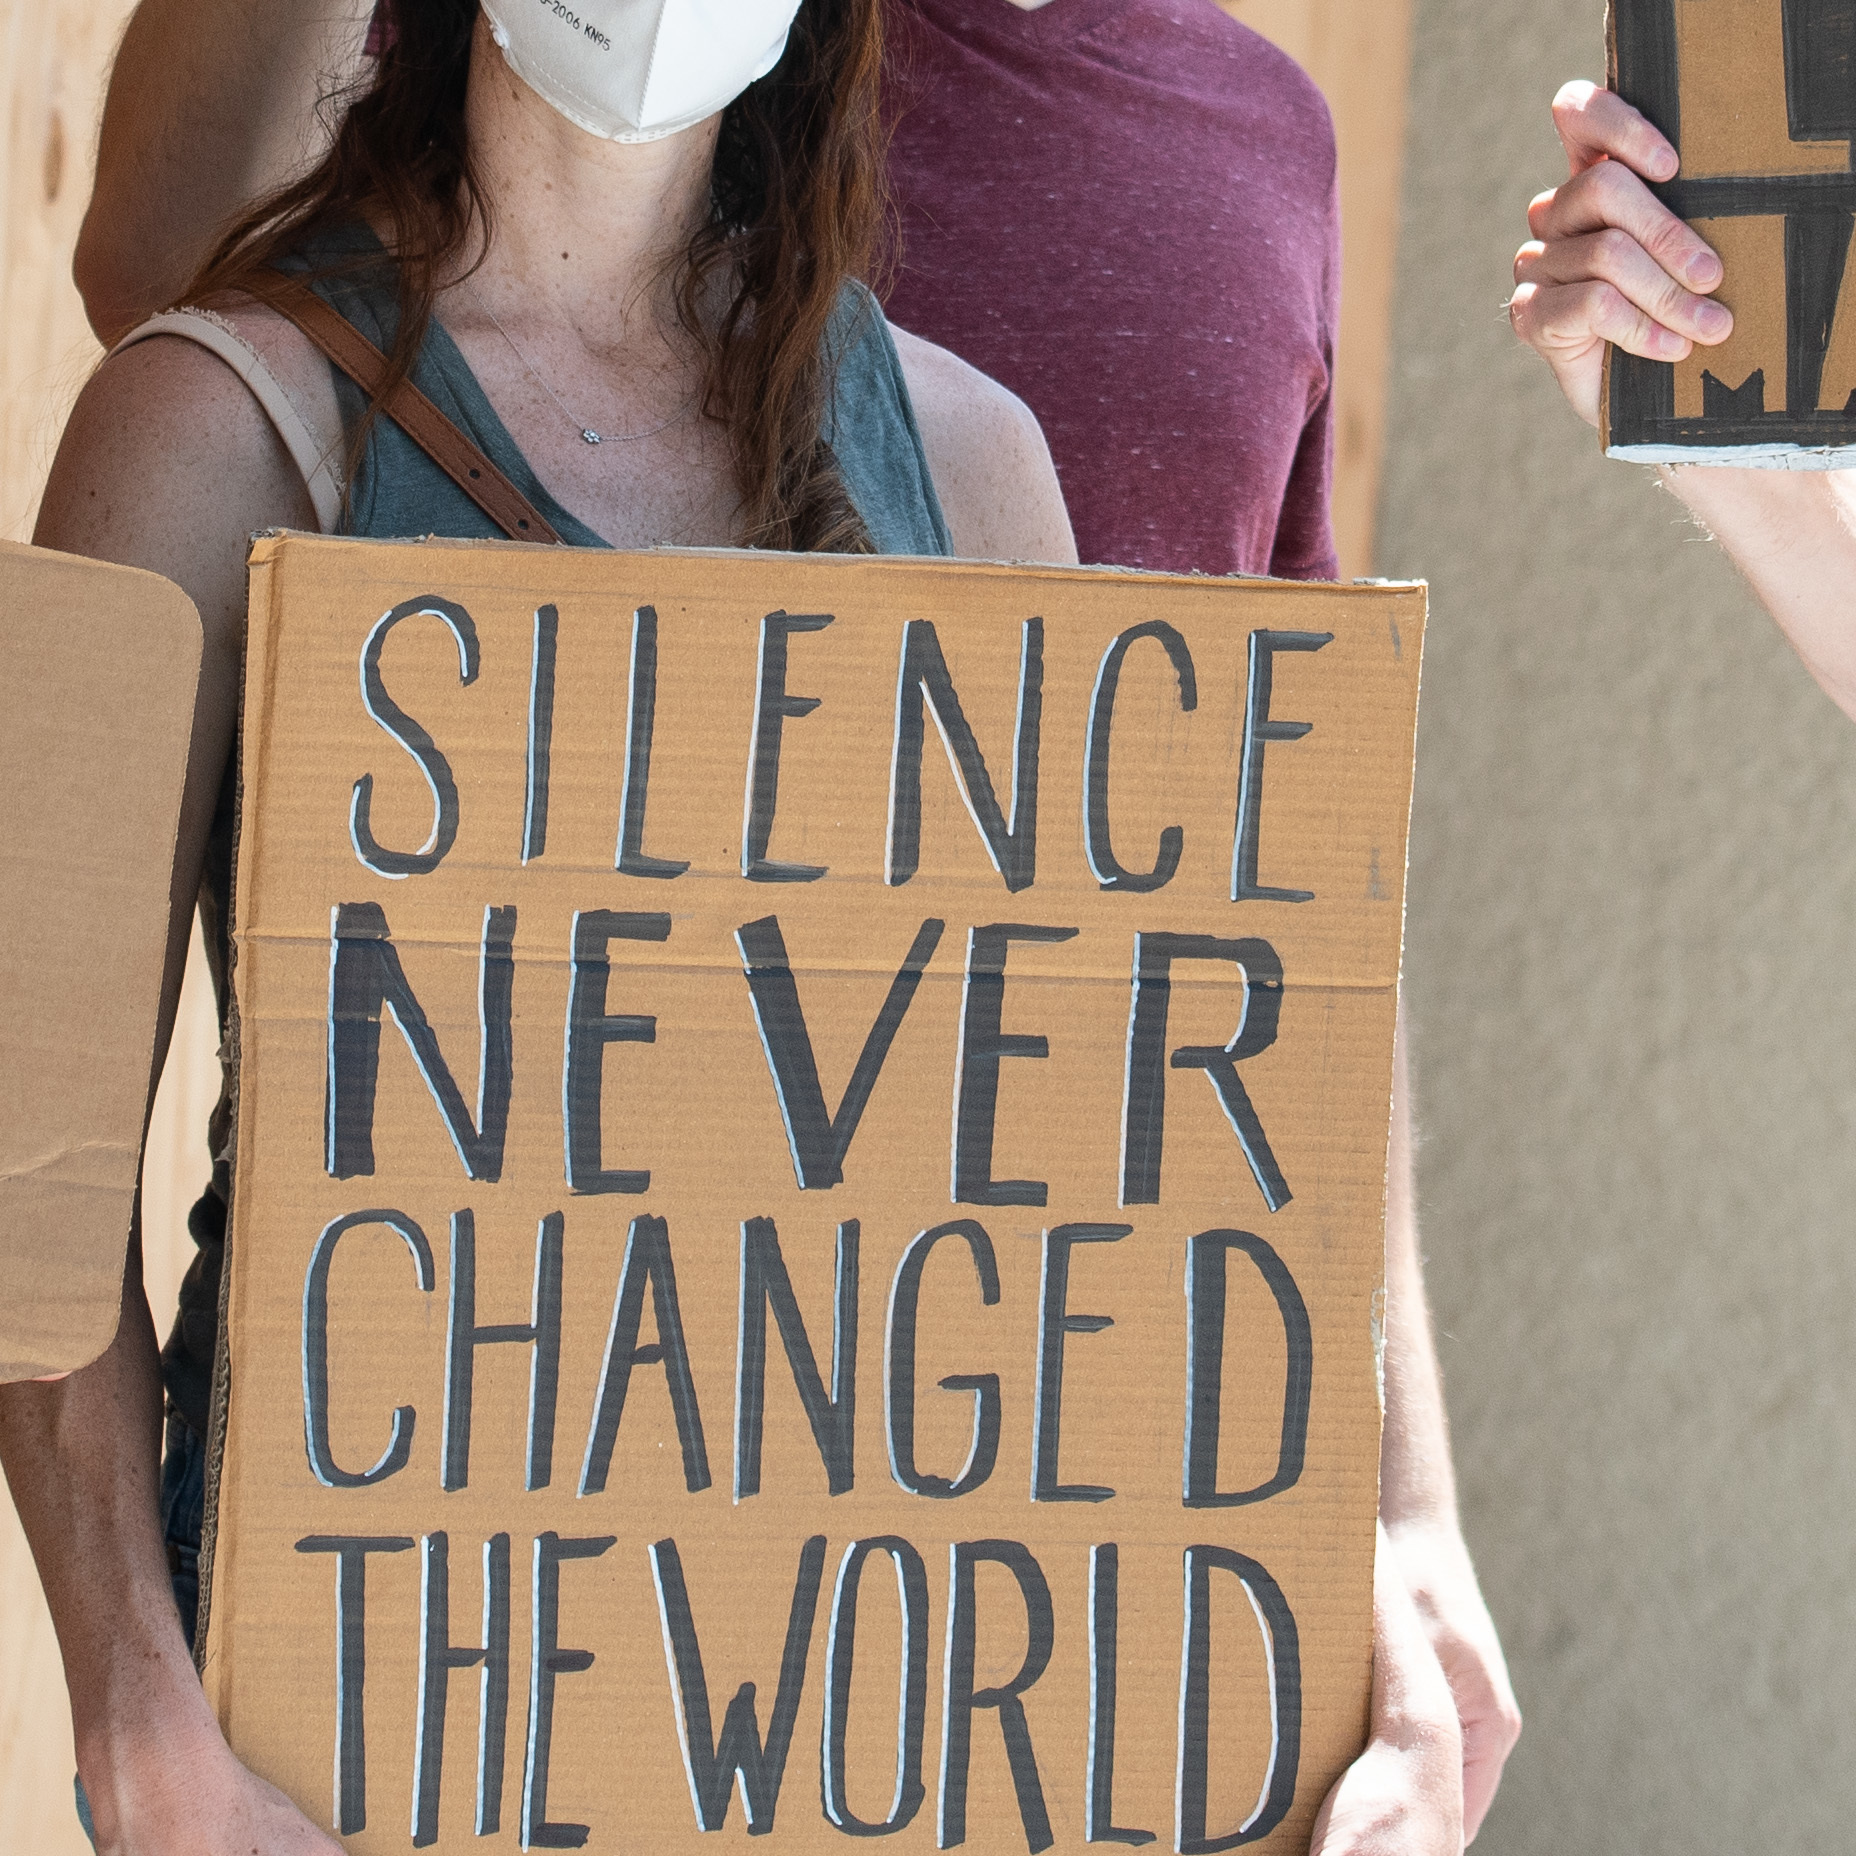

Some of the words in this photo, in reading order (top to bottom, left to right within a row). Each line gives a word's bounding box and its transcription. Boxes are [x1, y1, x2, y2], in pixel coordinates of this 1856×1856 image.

[584, 23, 612, 52] KN95
[348, 594, 1335, 904] SILENCE
[324, 901, 1296, 1214] NEVER
[302, 1207, 1314, 1509] CHANGED
[294, 1529, 619, 1855] THE
[648, 1534, 1302, 1856] WORLD
